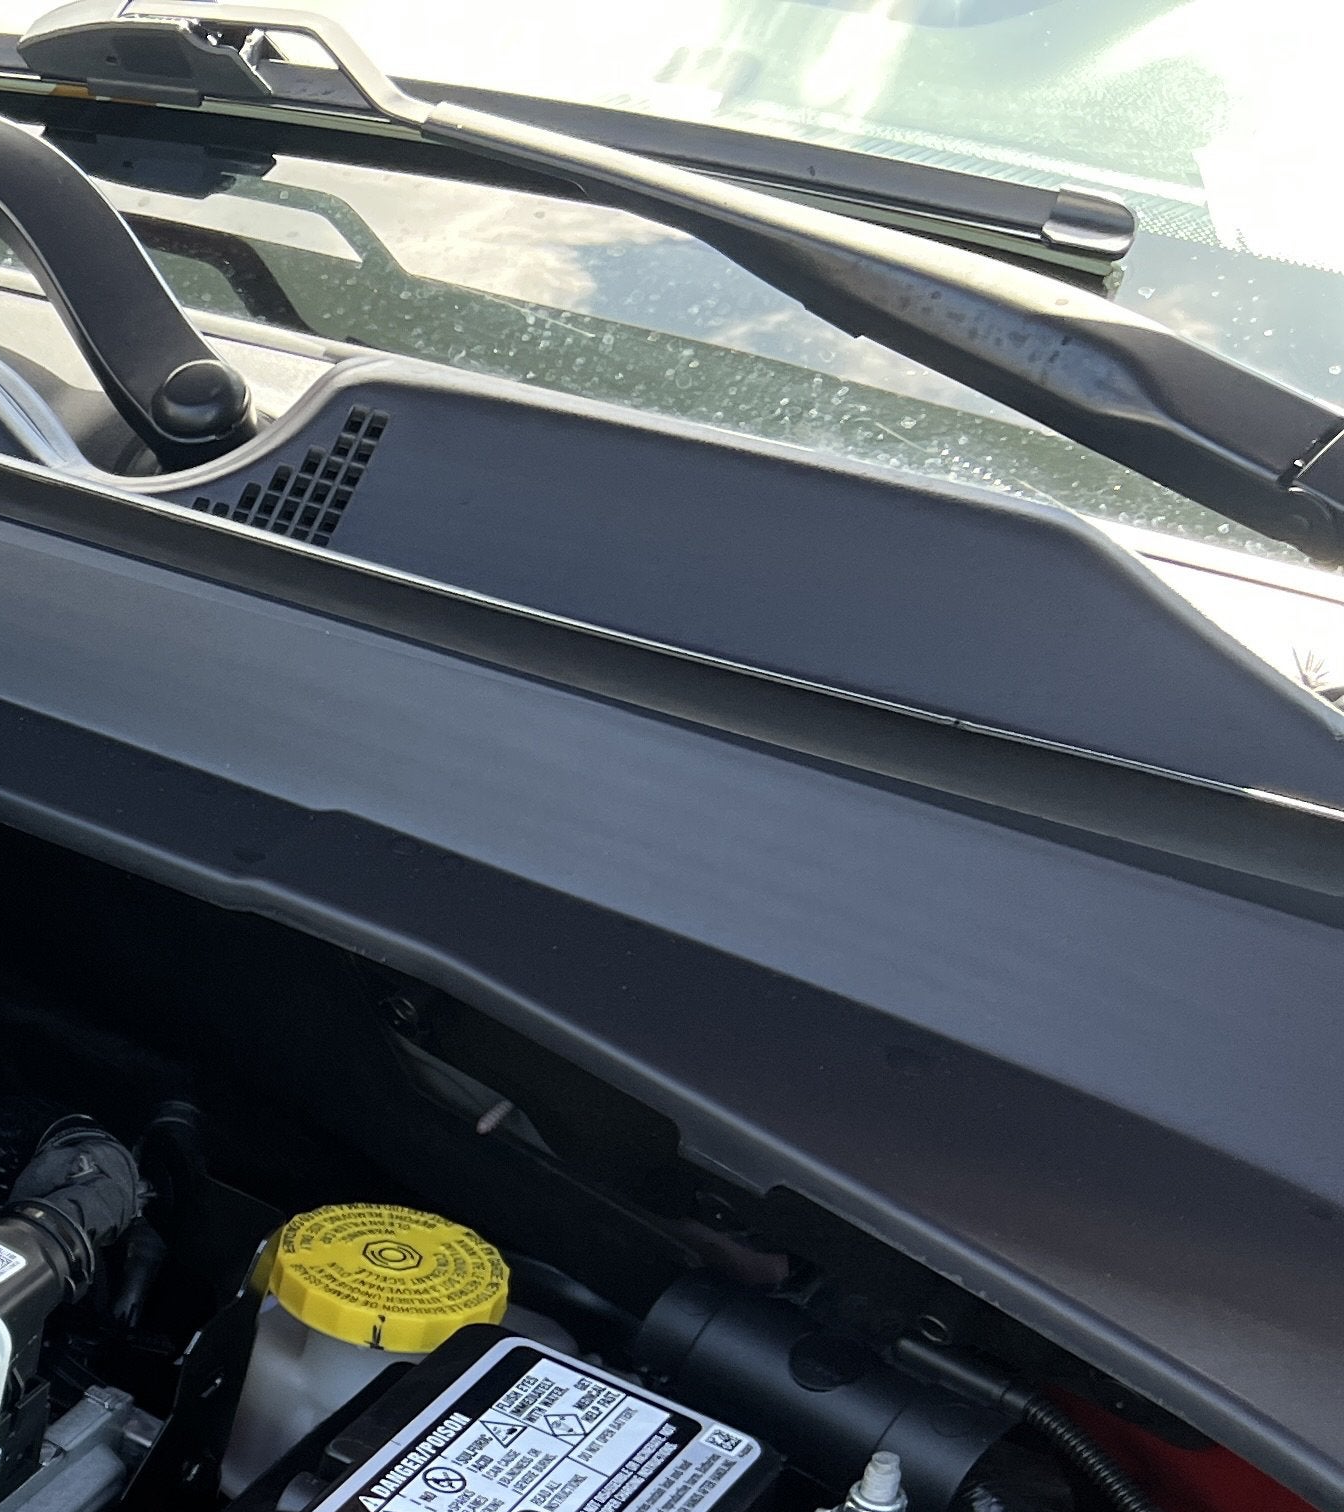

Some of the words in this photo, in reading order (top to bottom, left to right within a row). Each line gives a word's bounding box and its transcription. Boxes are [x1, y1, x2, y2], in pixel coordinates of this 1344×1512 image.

[495, 1389, 523, 1411] FLUSH
[515, 1374, 539, 1392] EYES
[508, 1377, 557, 1417] IMMEDIATELY
[571, 1383, 606, 1411] MEDICAL
[573, 1377, 593, 1390] GET
[522, 1405, 547, 1423] WITH
[538, 1383, 570, 1408] WATER.
[580, 1405, 604, 1423] HELP
[369, 1410, 471, 1498] DANGER/POISON
[454, 1433, 493, 1464] SULFURIC
[576, 1451, 592, 1461] DO
[584, 1440, 603, 1454] NOT
[594, 1427, 617, 1444] OPEN
[469, 1453, 494, 1471] ACID
[485, 1465, 503, 1478] CAN
[496, 1448, 520, 1467] CAUSE
[498, 1455, 534, 1484] BLINDNESS
[512, 1470, 539, 1491] SEVERE
[529, 1488, 552, 1506] READ
[543, 1478, 562, 1492] ALL
[418, 1490, 437, 1503] NO
